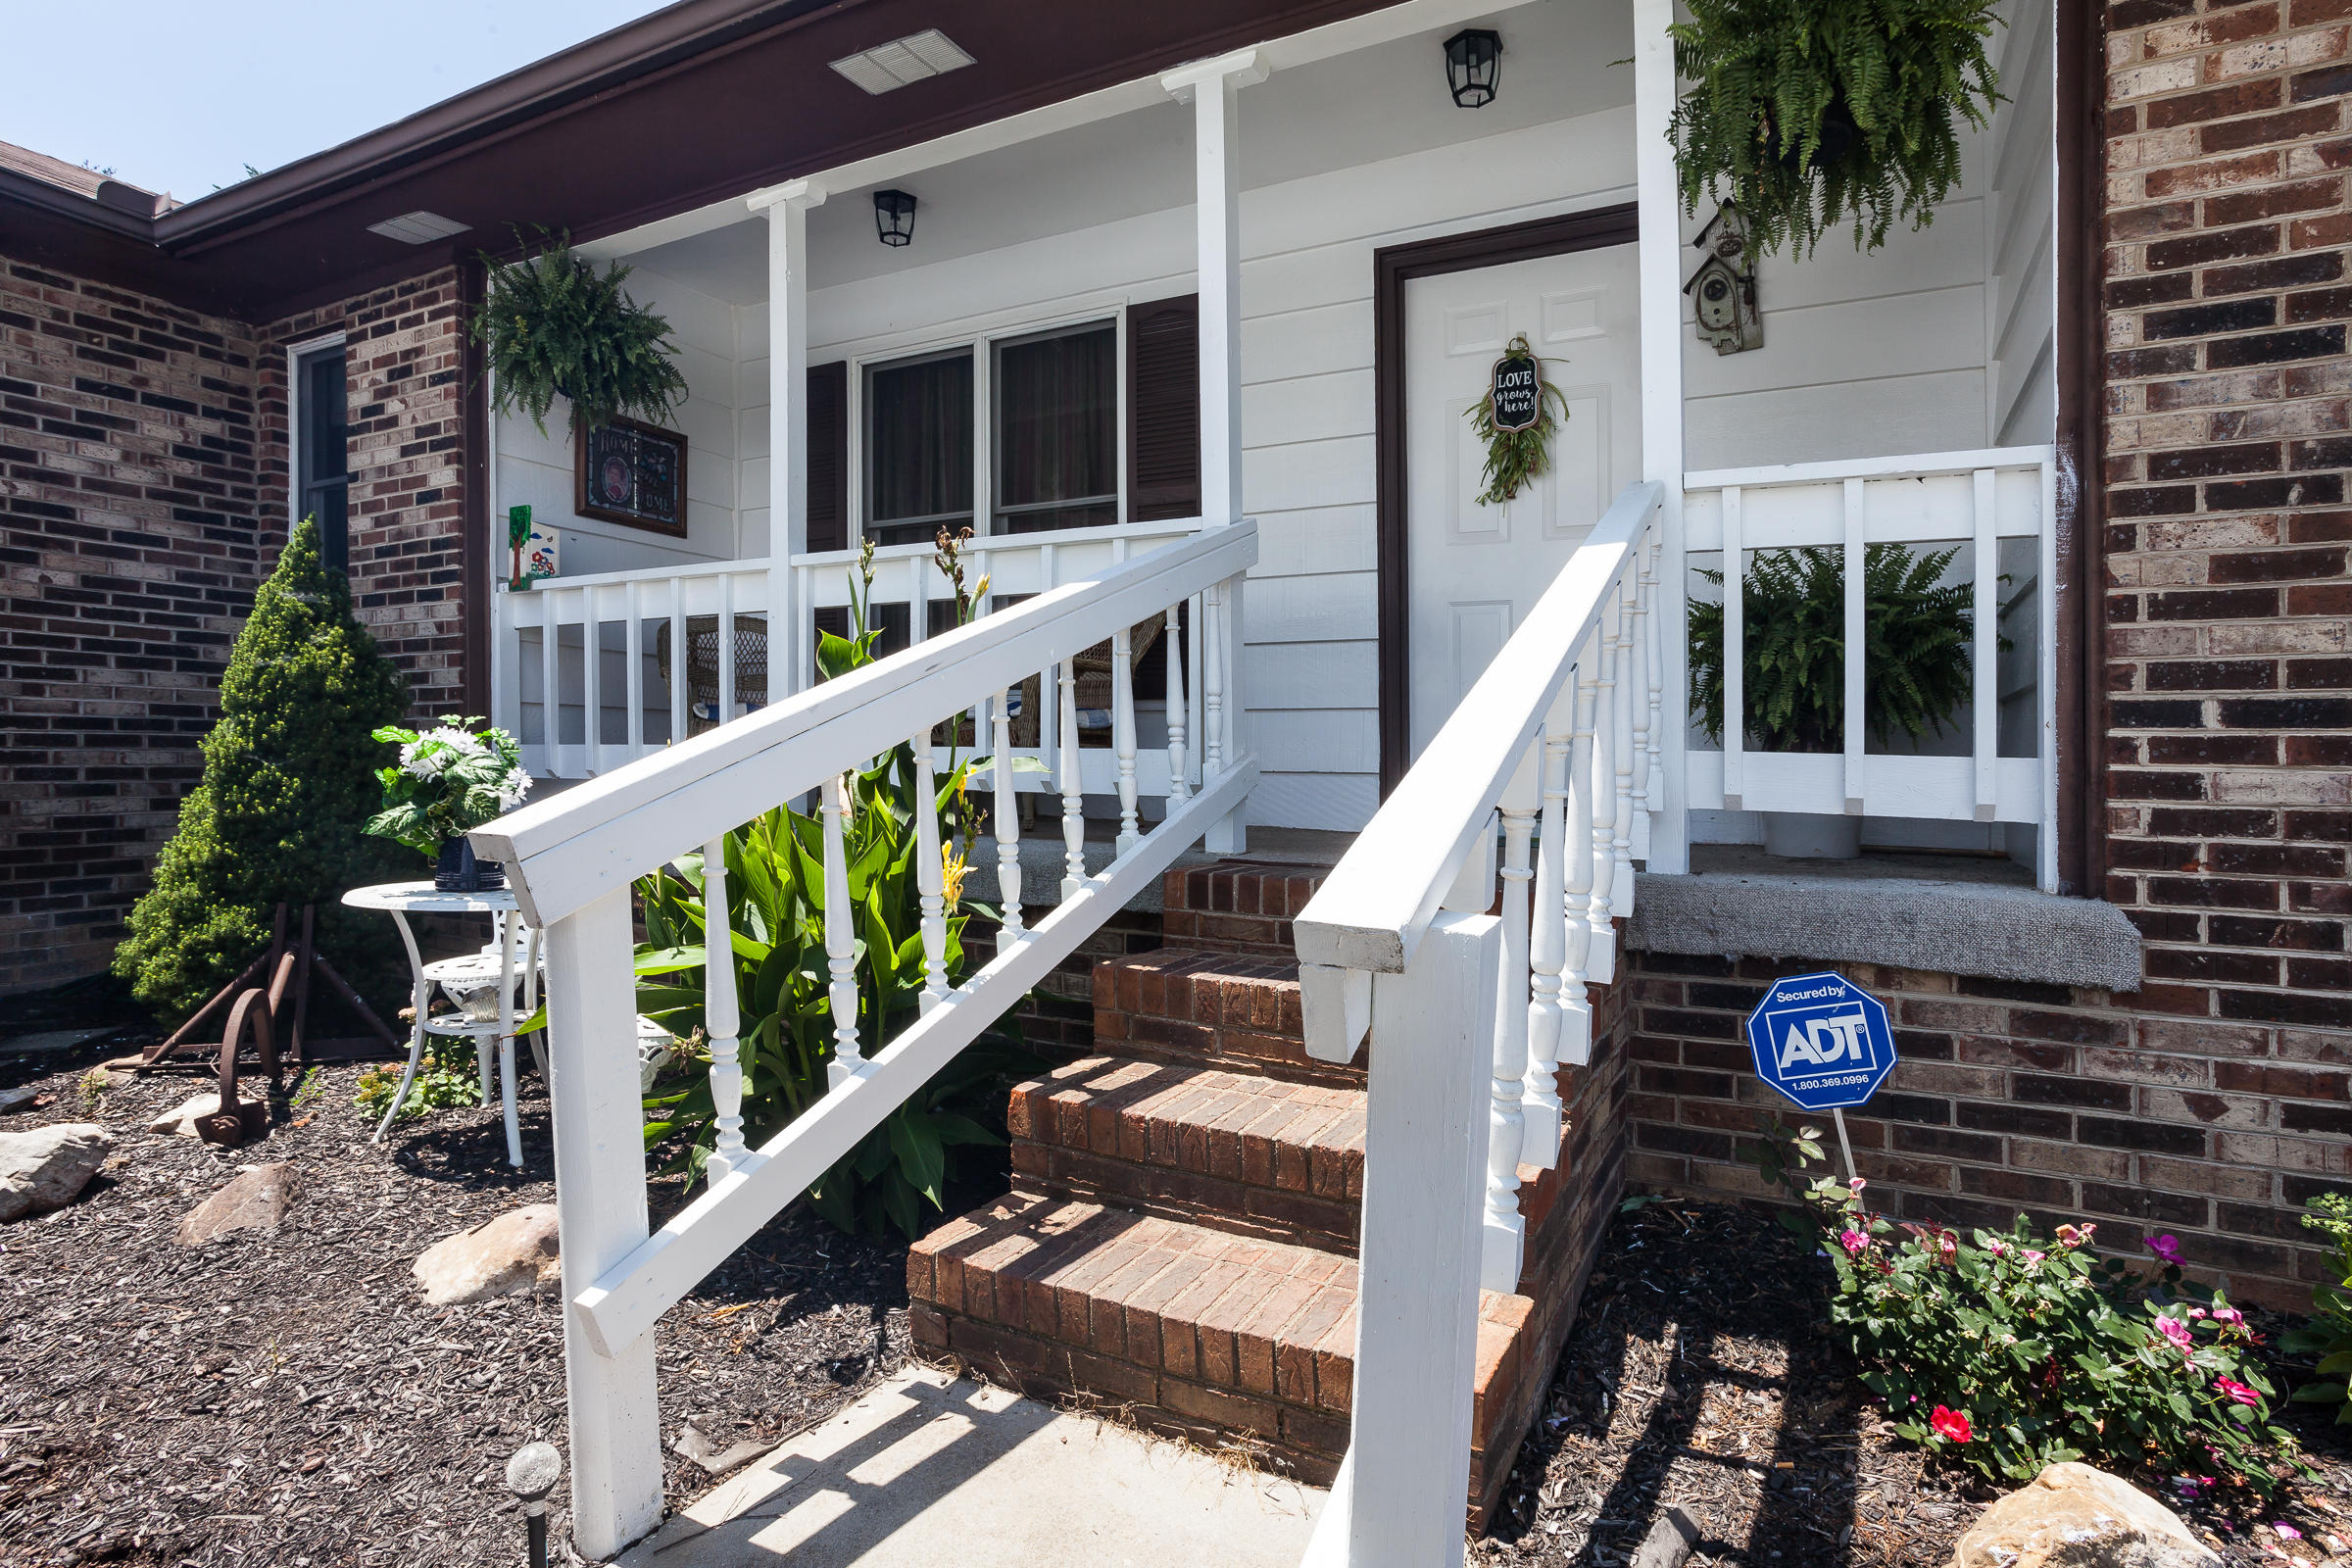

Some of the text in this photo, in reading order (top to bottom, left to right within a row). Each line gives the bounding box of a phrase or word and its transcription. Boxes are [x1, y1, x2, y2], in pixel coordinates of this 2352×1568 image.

[1497, 370, 1532, 388] LOVE
[1496, 389, 1533, 406] grows
[1504, 396, 1534, 413] here!
[1777, 985, 1843, 1003] Secured by
[1780, 1013, 1865, 1068] ADT
[1791, 1074, 1870, 1091] 1.800.369.0996
